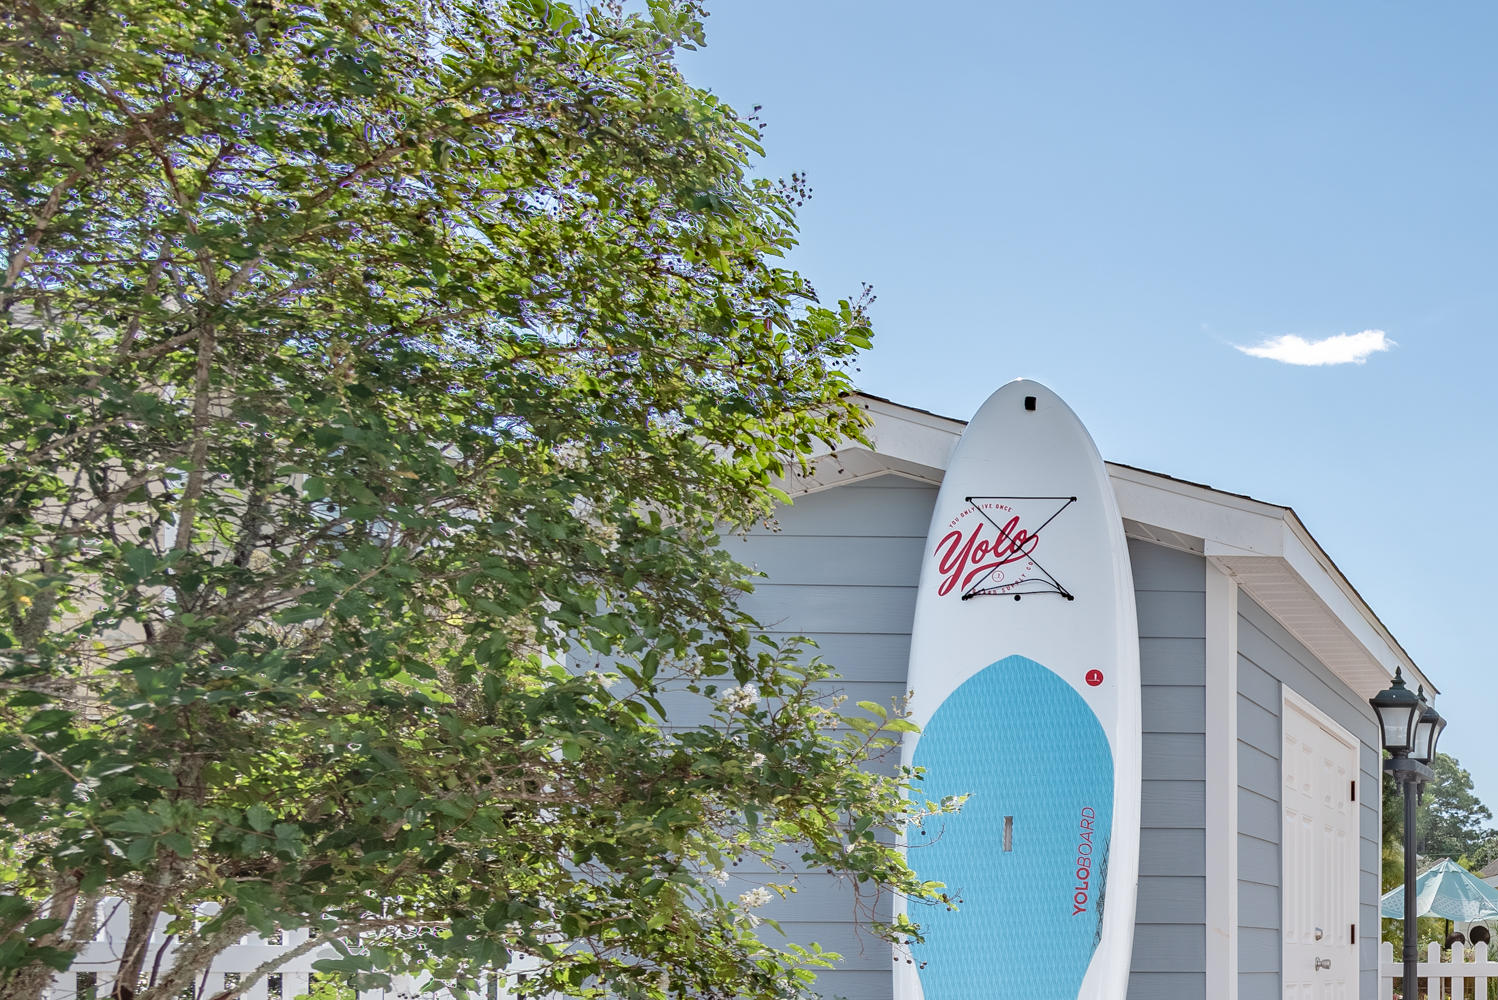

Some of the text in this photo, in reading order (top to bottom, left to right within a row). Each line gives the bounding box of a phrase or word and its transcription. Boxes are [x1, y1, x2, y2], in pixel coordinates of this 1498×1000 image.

[949, 516, 960, 528] YOU
[960, 506, 976, 518] ONLY
[995, 503, 1012, 513] ONCE
[934, 515, 1039, 597] Yolo
